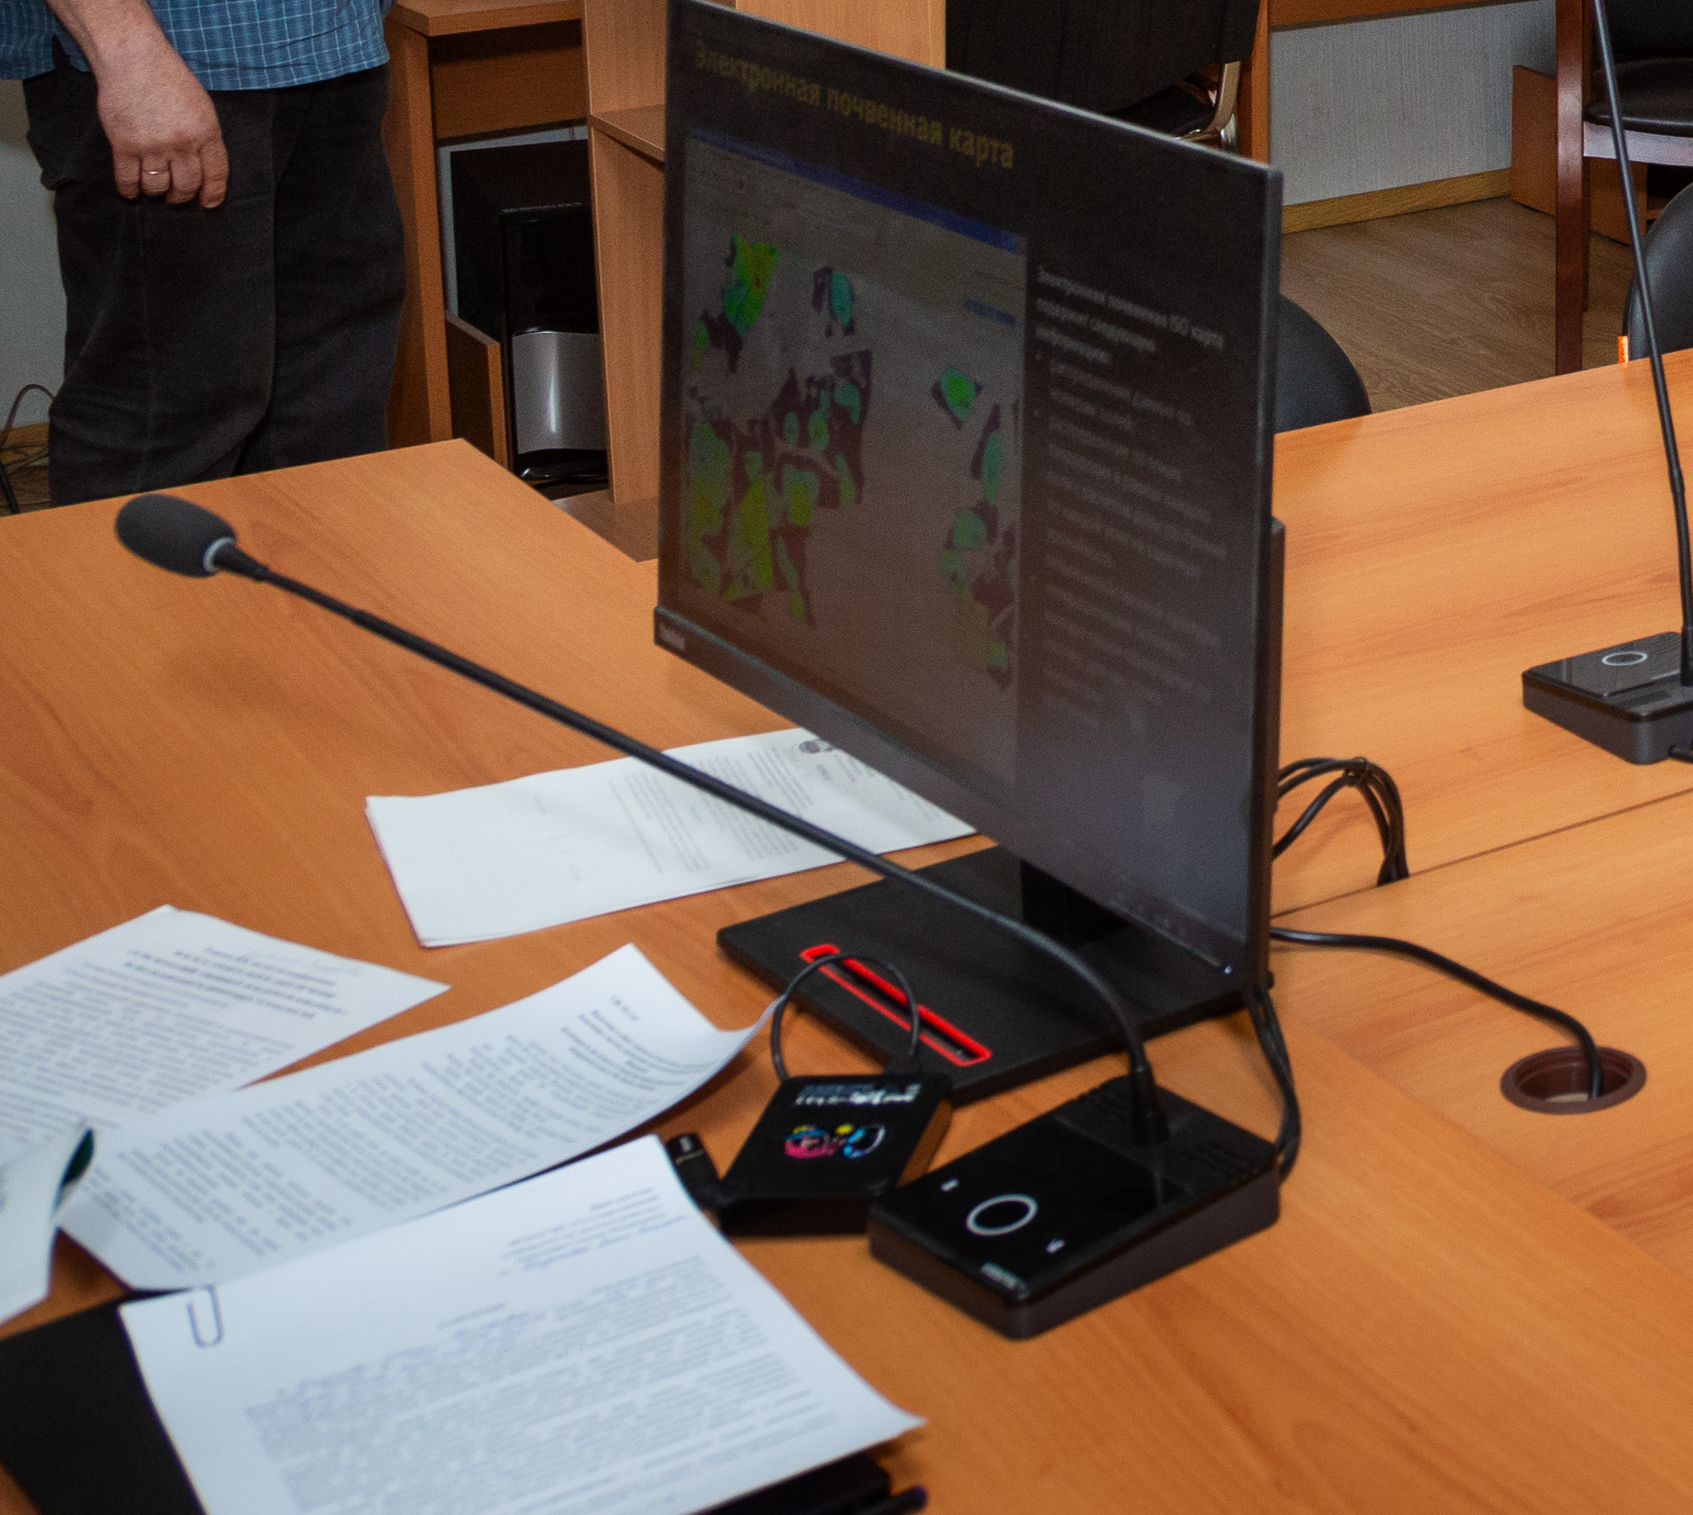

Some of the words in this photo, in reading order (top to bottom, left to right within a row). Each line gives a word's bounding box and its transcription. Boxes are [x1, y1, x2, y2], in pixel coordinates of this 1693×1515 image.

[696, 40, 821, 108] Электронная
[826, 86, 943, 147] почвенная
[949, 125, 1015, 171] карта
